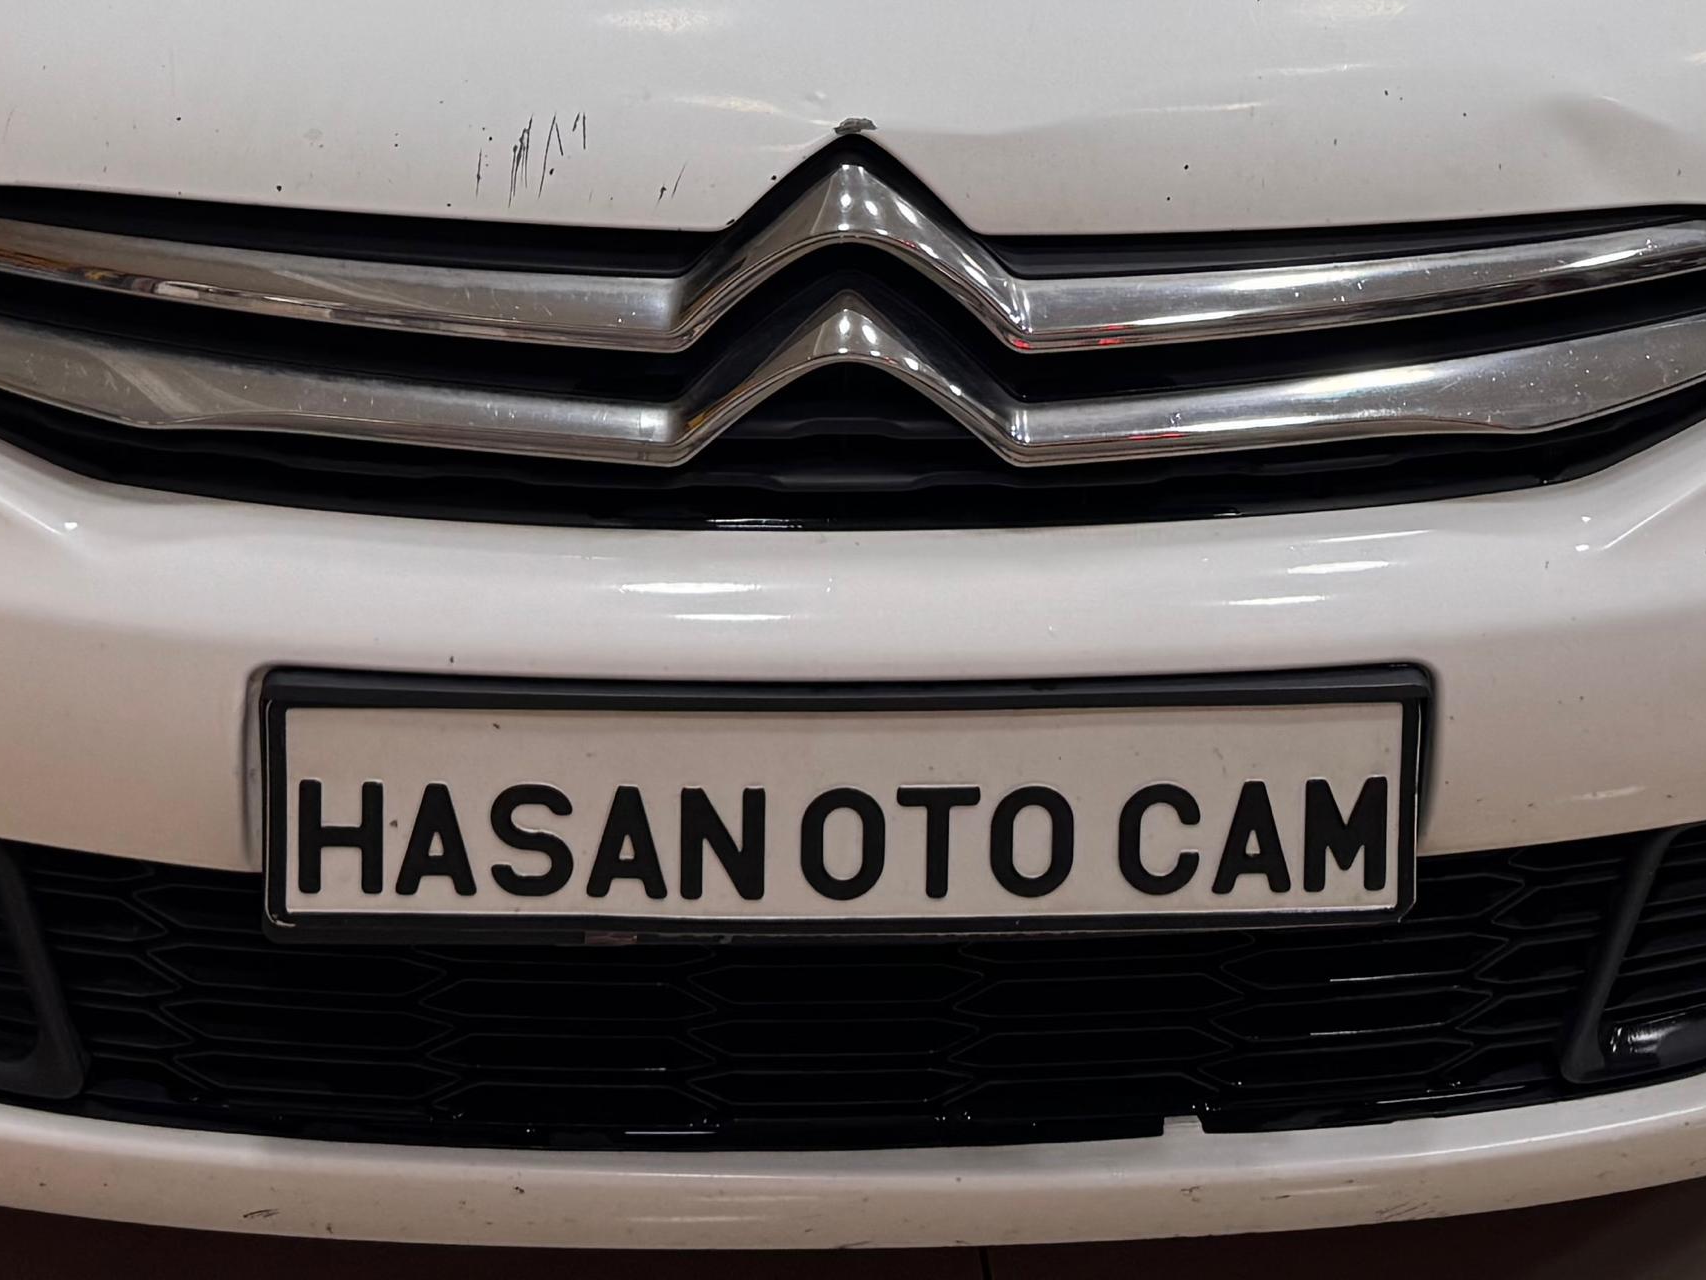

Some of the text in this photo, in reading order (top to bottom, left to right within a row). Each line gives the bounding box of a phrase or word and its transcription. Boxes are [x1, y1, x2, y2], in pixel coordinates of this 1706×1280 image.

[297, 775, 1389, 902] HASAN OTO CAM
